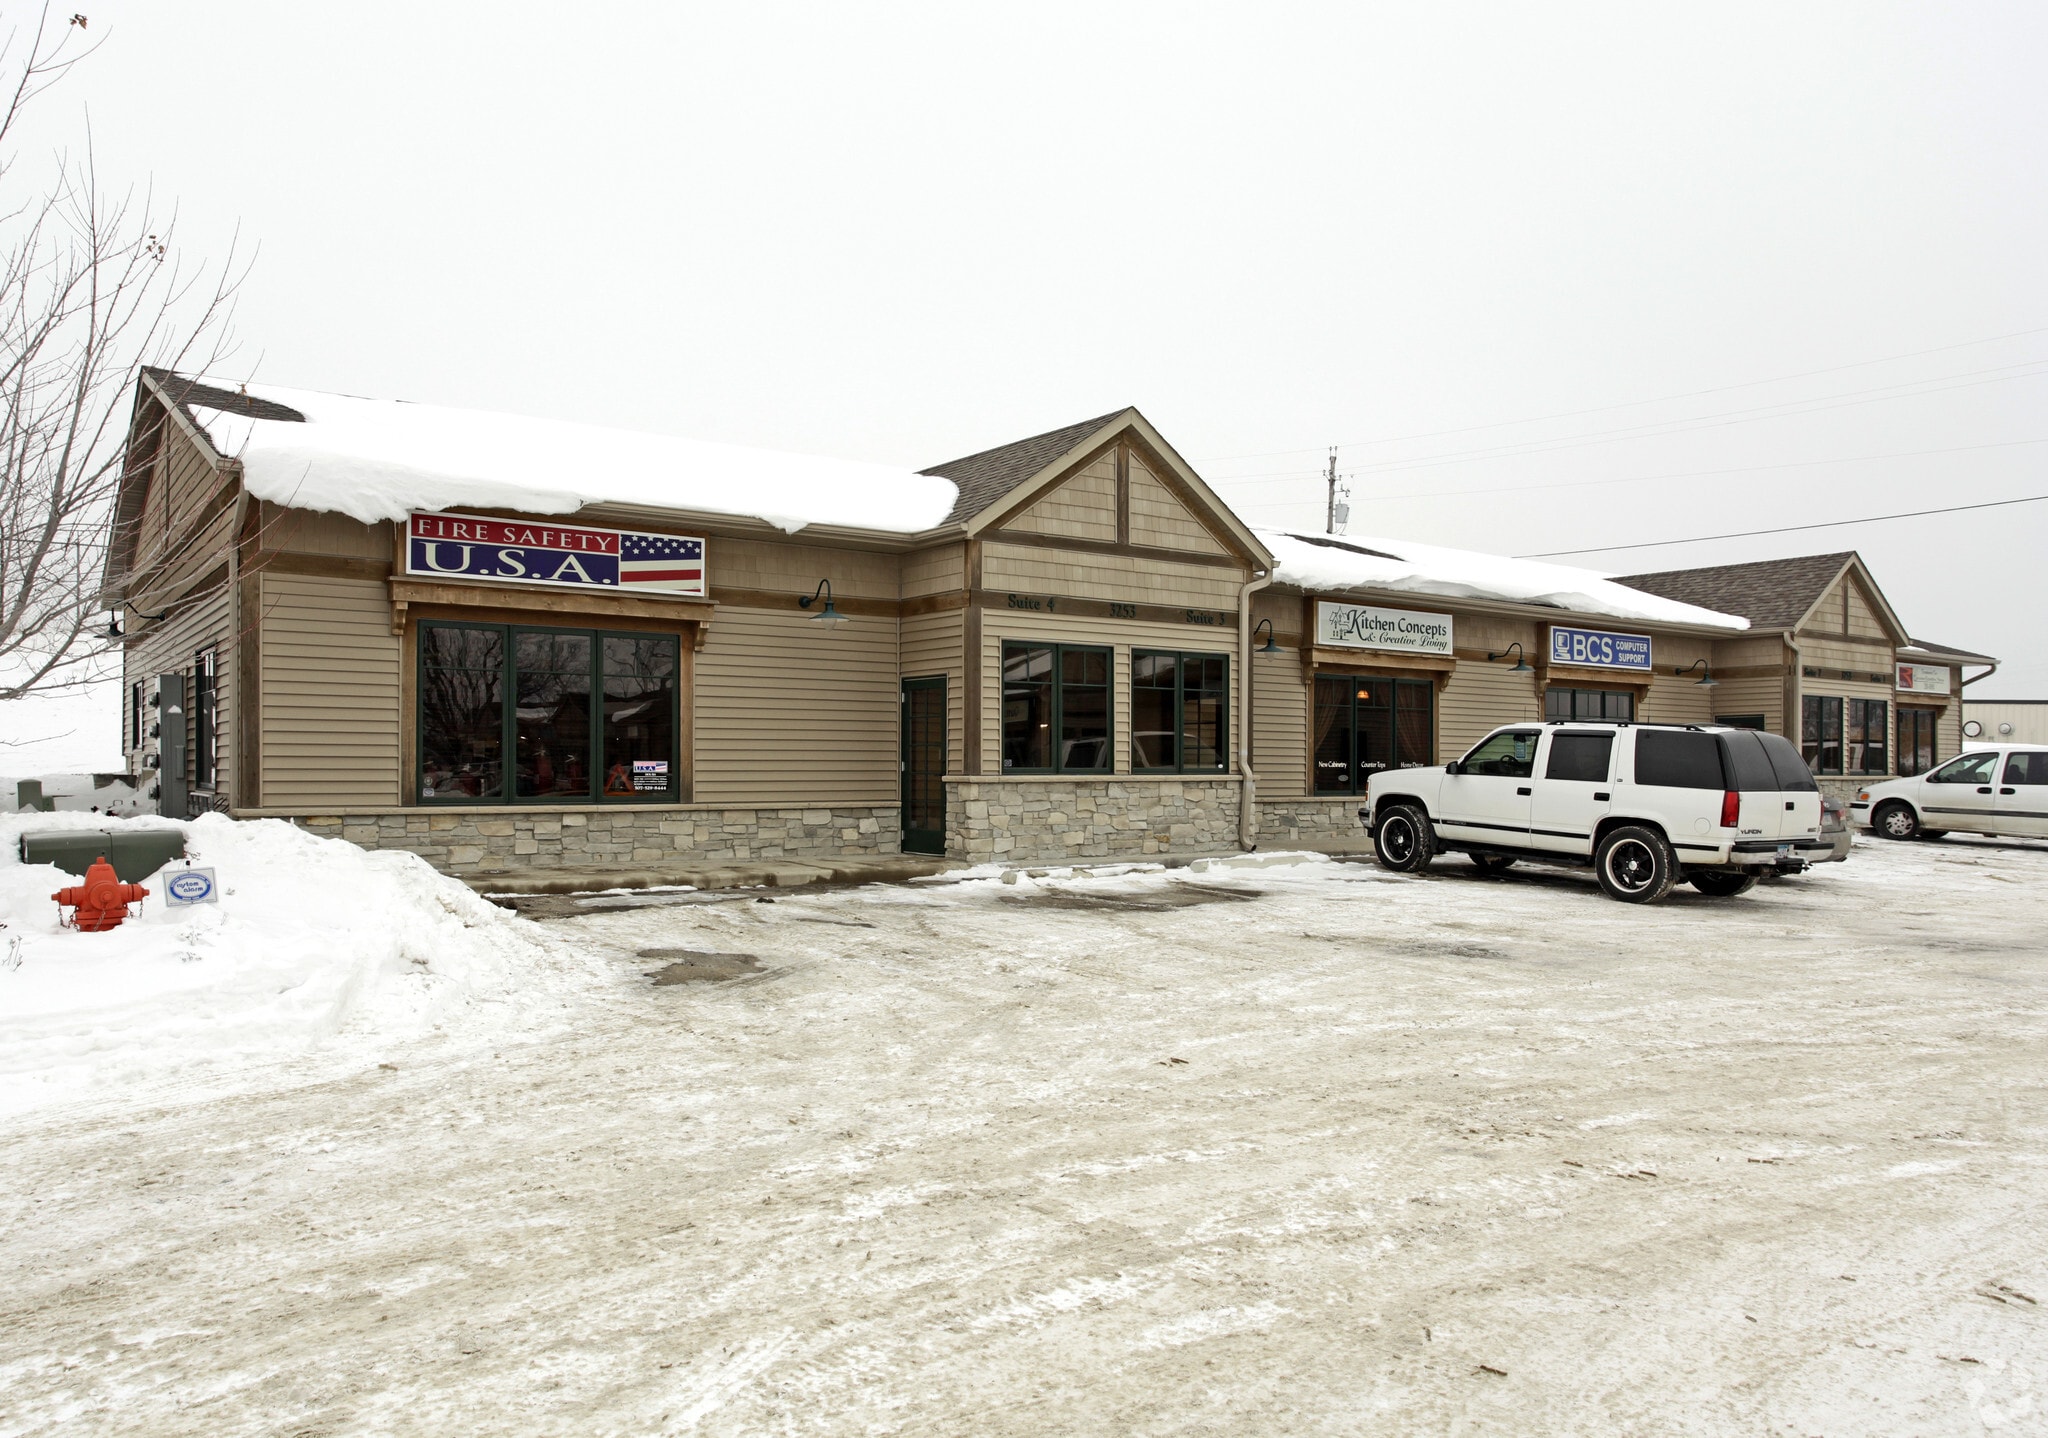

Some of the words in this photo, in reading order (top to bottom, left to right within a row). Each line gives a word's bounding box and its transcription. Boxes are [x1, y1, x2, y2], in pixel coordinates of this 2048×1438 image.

[418, 519, 488, 540] FIRE
[503, 527, 612, 551] SAFETY
[419, 542, 612, 584] U.S.A.
[1008, 594, 1040, 610] Suite
[1047, 596, 1054, 611] 4
[1110, 603, 1136, 618] 3253
[1186, 609, 1214, 624] Suite
[1218, 612, 1225, 626] 3
[1346, 610, 1395, 641] Kitchen
[1398, 618, 1447, 639] Concepts
[1367, 632, 1376, 642] &
[1379, 632, 1416, 645] Creative
[1418, 636, 1448, 650] Living
[1573, 634, 1612, 663] BCS
[1616, 641, 1648, 652] COMPUTER
[1618, 653, 1645, 663] SUPPORT
[1377, 761, 1386, 769] Tops
